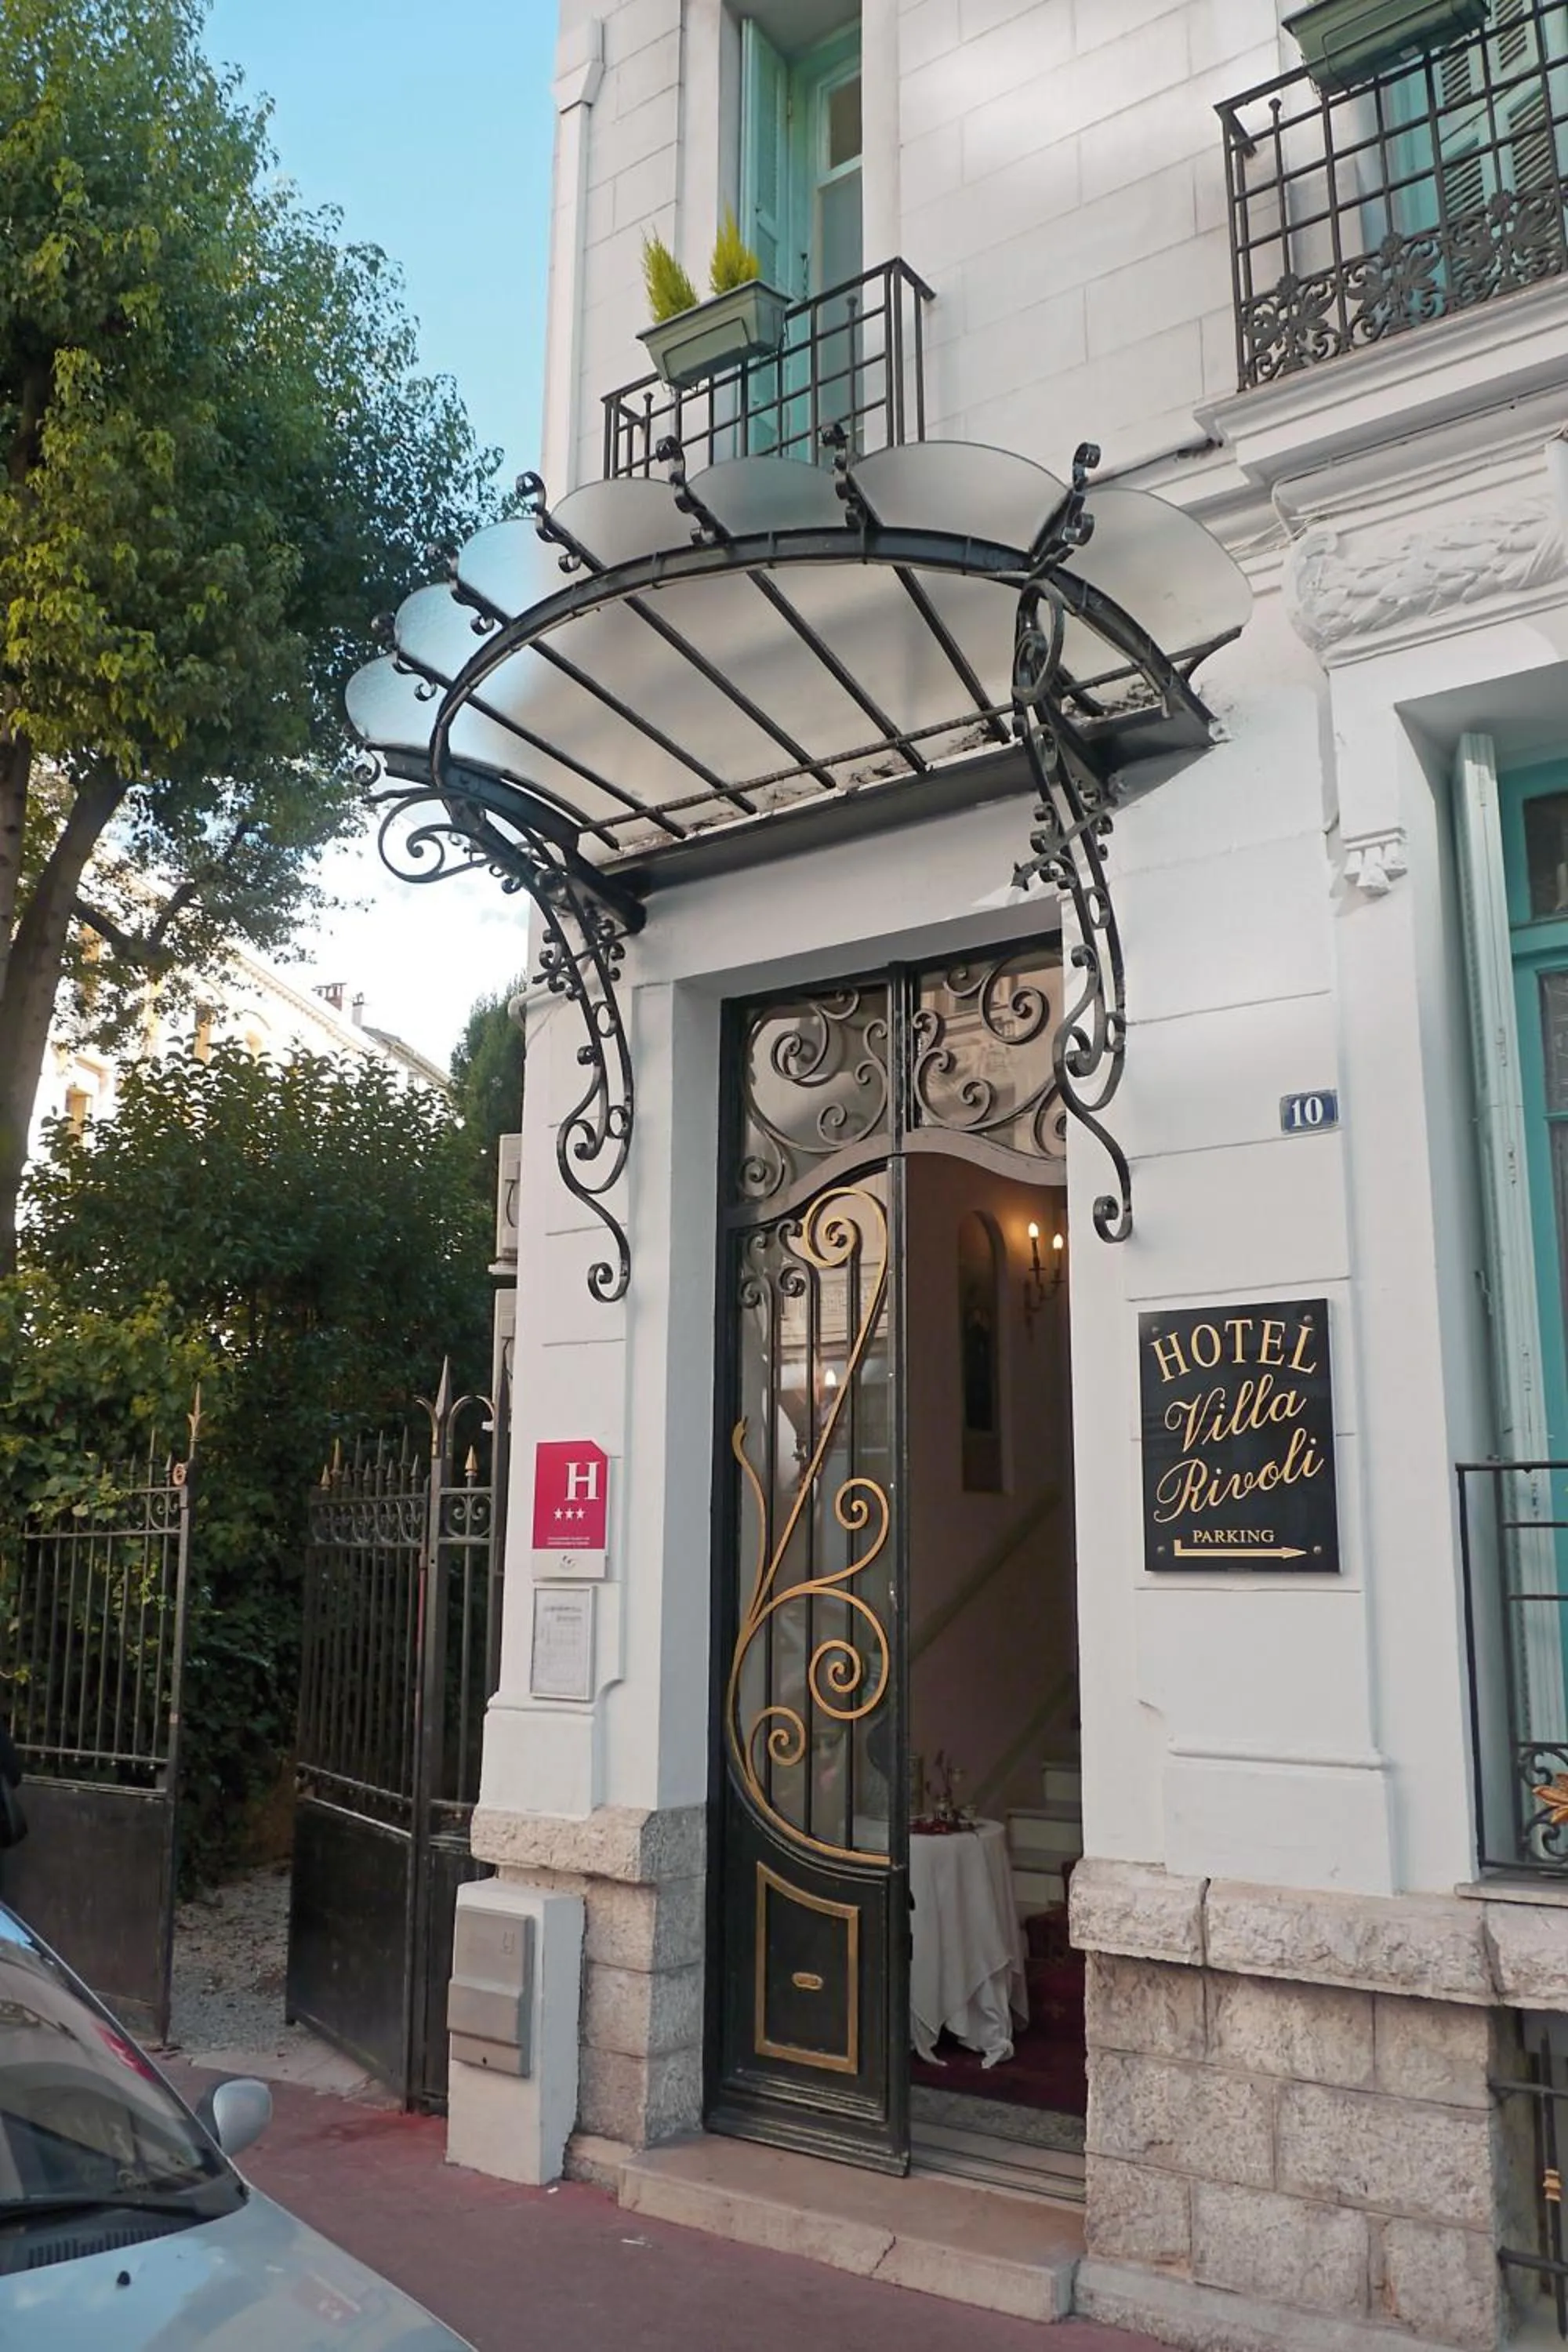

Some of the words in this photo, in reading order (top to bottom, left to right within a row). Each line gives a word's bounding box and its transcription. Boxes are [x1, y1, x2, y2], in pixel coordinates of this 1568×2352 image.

[1291, 1097, 1323, 1127] 10
[1148, 1319, 1318, 1383] HOTEL
[1164, 1373, 1307, 1453] Villa
[564, 1461, 602, 1502] H
[1153, 1427, 1325, 1523] Rivoli
[1192, 1530, 1275, 1544] PARKING
